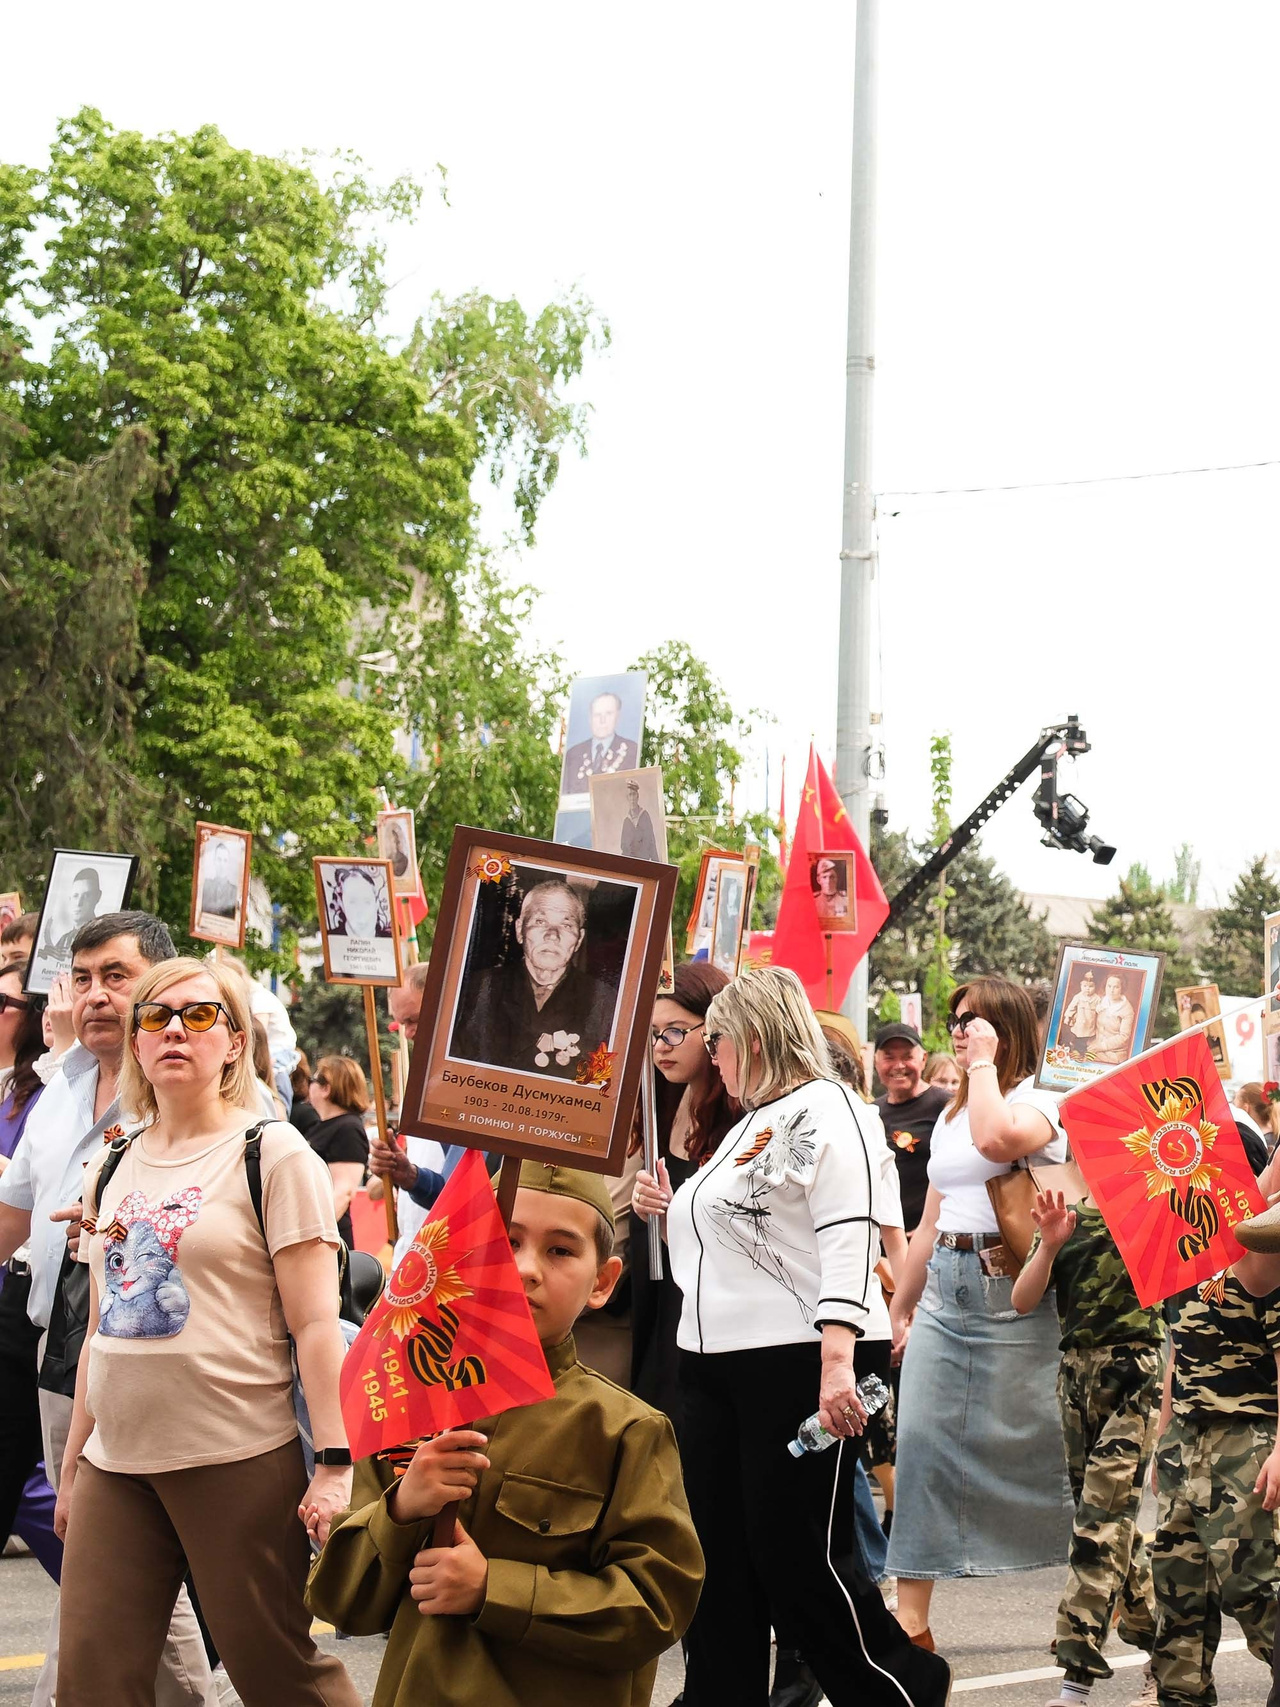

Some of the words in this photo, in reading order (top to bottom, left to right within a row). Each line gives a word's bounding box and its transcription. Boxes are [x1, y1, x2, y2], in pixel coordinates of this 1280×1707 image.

[442, 1070, 508, 1094] Баубеков
[512, 1084, 602, 1113] Дусмухамед
[463, 1095, 489, 1108] 1903
[501, 1102, 569, 1124] 20.08.1979г.
[458, 1112, 466, 1121] Я
[469, 1113, 514, 1131] ПОМНЮ!
[517, 1124, 525, 1132] Я
[528, 1125, 582, 1144] ГОРЖУСЬ!
[387, 1292, 423, 1306] ВОЙНА
[381, 1346, 410, 1399] 1941
[361, 1368, 389, 1422] 1945
